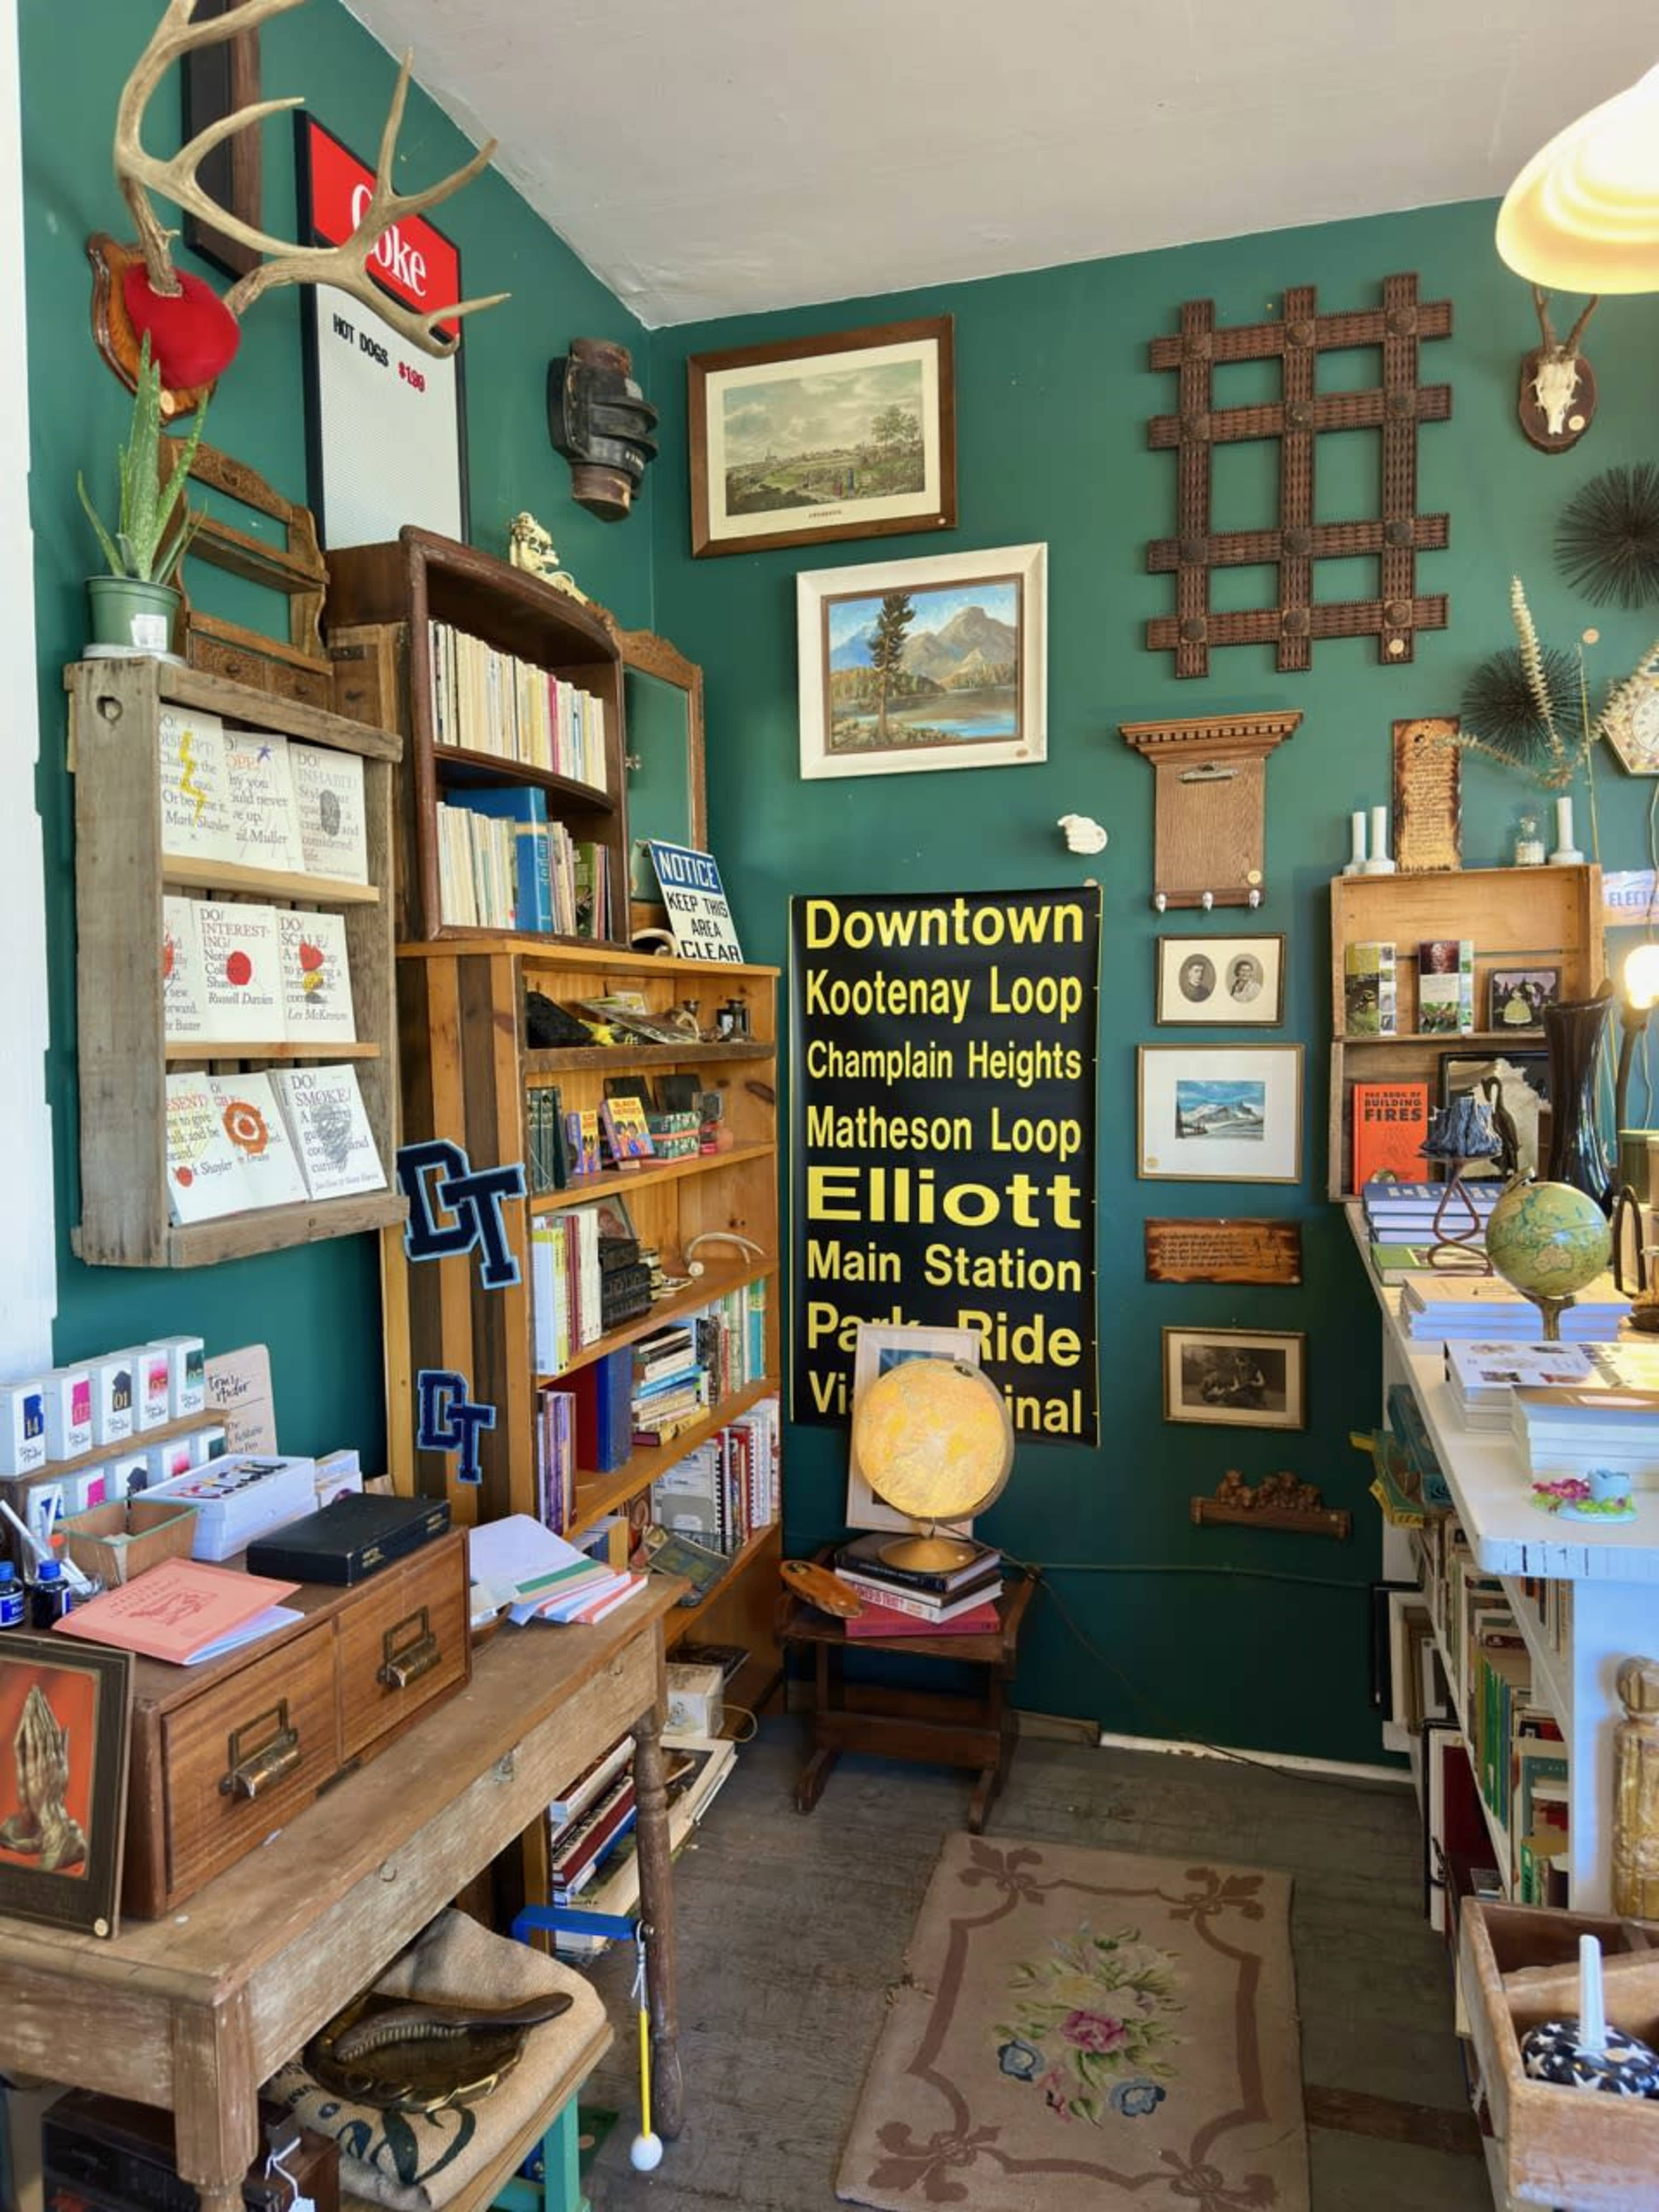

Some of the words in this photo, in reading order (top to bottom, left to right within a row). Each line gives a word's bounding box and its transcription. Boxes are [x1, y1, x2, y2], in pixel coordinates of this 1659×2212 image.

[333, 313, 355, 344] HOT
[359, 332, 388, 367] DOGS
[659, 852, 719, 890] NOTICE
[667, 895, 698, 913] KEEP
[702, 898, 729, 918] THIS
[692, 918, 722, 938] AREA
[806, 898, 1084, 949] Downtown
[203, 935, 231, 948] ING/
[680, 940, 741, 962] CLEAR
[806, 969, 971, 1024] Kootenay
[990, 965, 1082, 1024] Loop
[291, 1074, 316, 1090] DO/
[807, 1039, 953, 1086] Champlain
[968, 1040, 1082, 1088] Heights
[295, 1089, 352, 1107] SMOKE/
[1365, 1098, 1421, 1106] BUILDING
[1365, 1107, 1421, 1122] FIRES
[807, 1105, 973, 1150] Matheson
[991, 1107, 1081, 1162] Loop
[396, 1138, 528, 1290] DT
[808, 1166, 1081, 1229] Elliott
[808, 1239, 901, 1283] Main
[924, 1243, 1081, 1292] Station
[957, 1309, 1081, 1368] Ride
[416, 1370, 496, 1484] DT
